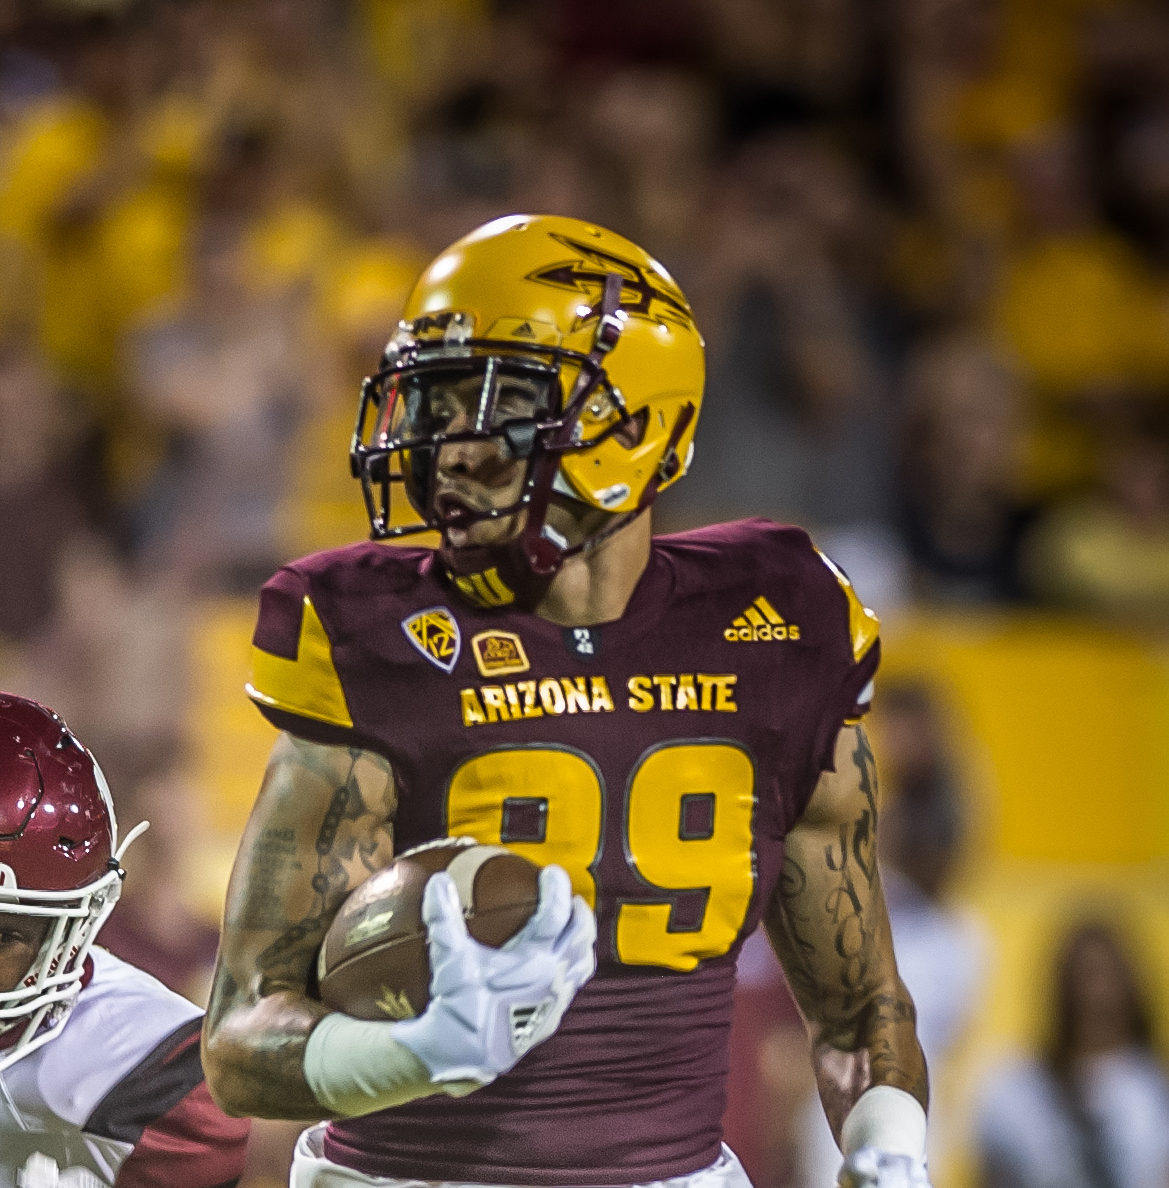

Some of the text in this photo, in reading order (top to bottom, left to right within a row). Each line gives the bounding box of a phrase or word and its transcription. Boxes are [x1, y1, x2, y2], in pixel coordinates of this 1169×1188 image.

[724, 624, 800, 642] adidas
[460, 673, 738, 726] ARIZONA STATE
[445, 741, 757, 972] 89
